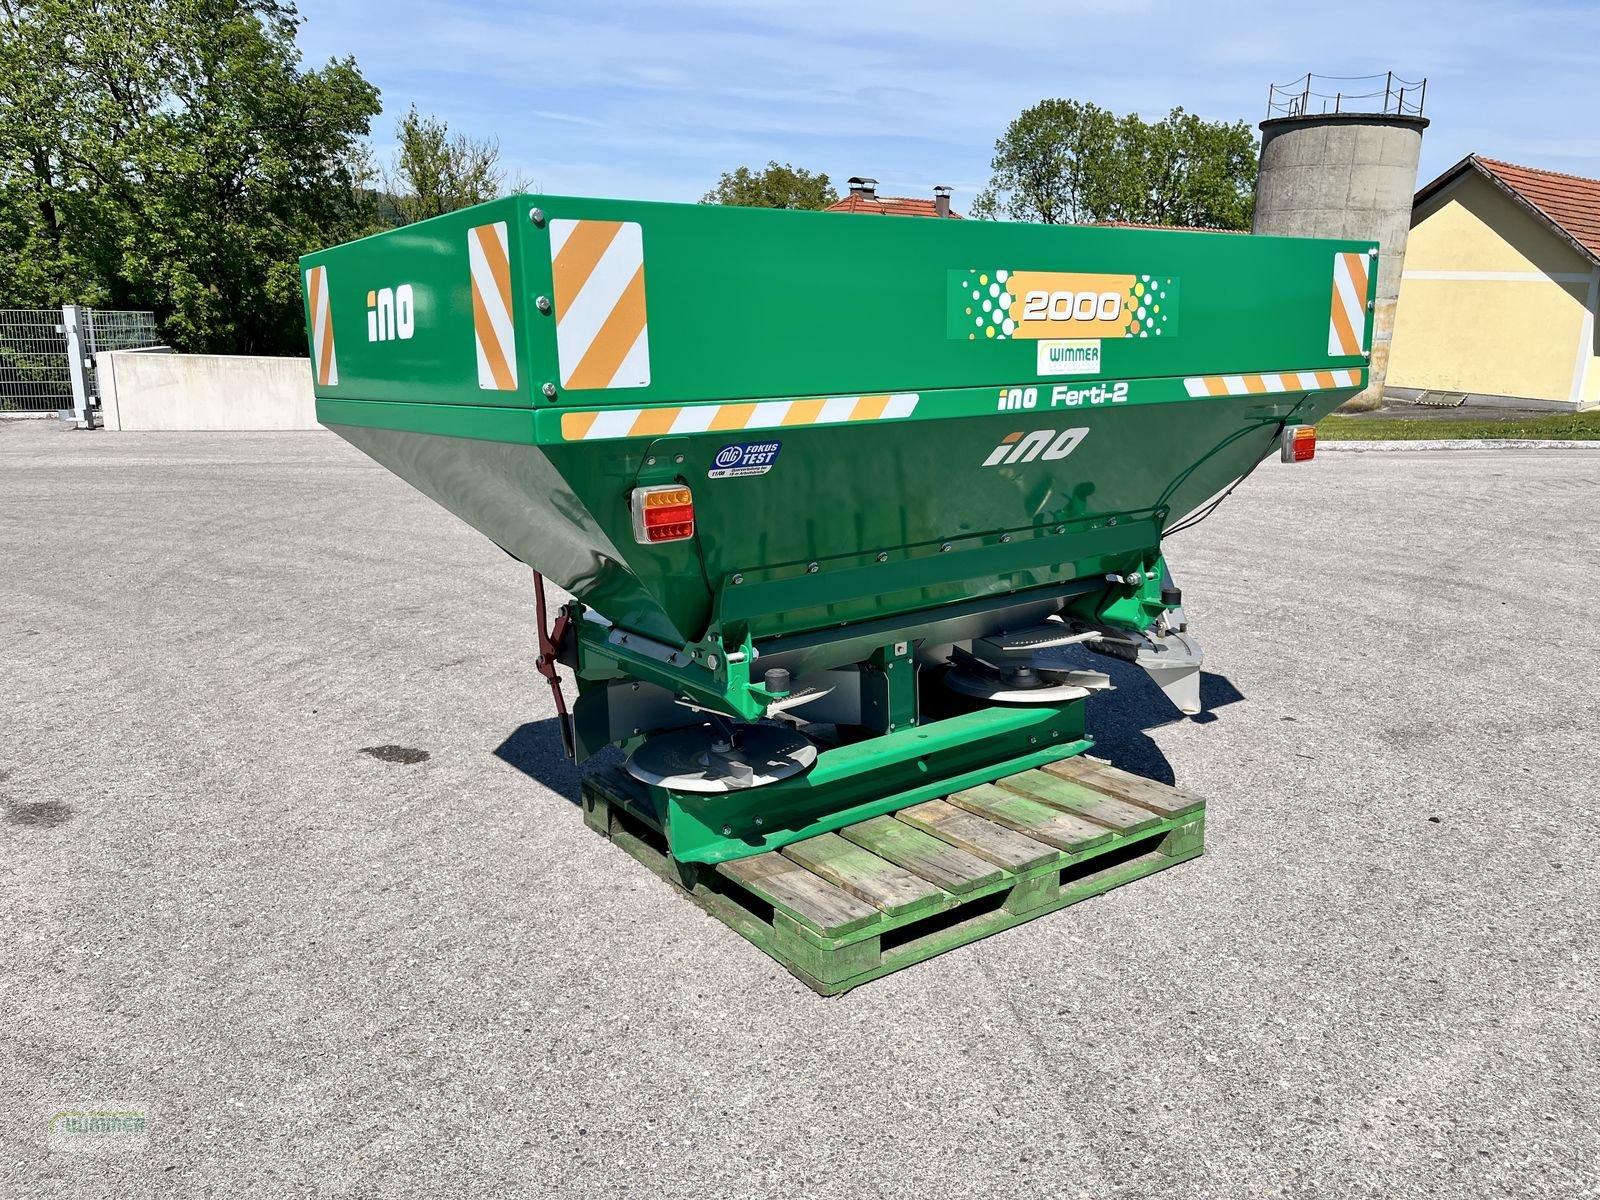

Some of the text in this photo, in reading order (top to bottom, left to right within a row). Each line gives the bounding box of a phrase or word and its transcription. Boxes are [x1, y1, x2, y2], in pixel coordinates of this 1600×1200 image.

[1023, 290, 1122, 321] 2000
[1049, 347, 1099, 362] WIMMER
[1051, 382, 1129, 407] Ferti-2
[745, 444, 779, 453] FOKUS
[742, 452, 775, 464] TEST
